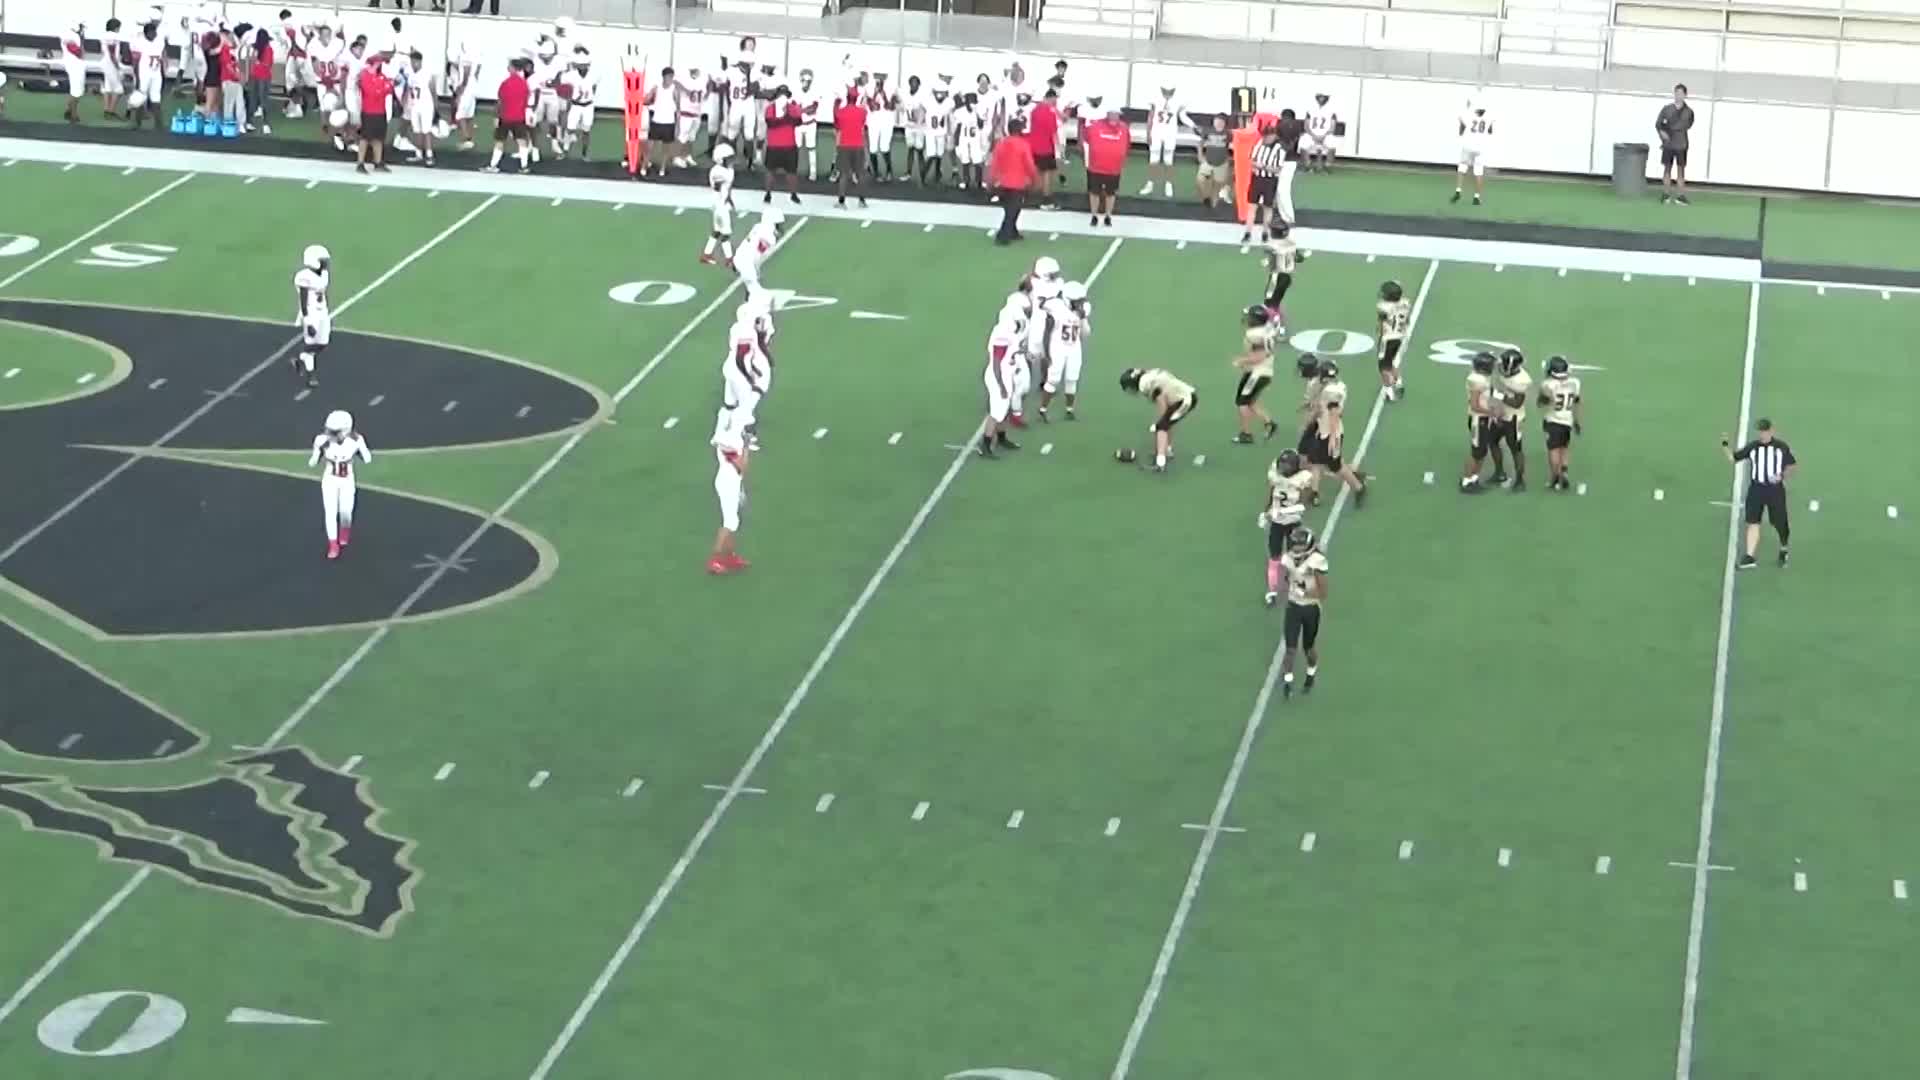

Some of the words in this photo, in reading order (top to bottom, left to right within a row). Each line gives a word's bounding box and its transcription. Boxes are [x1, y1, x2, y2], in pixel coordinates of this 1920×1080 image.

[1238, 88, 1250, 113] 1
[1157, 111, 1174, 124] 57
[963, 125, 976, 138] 16
